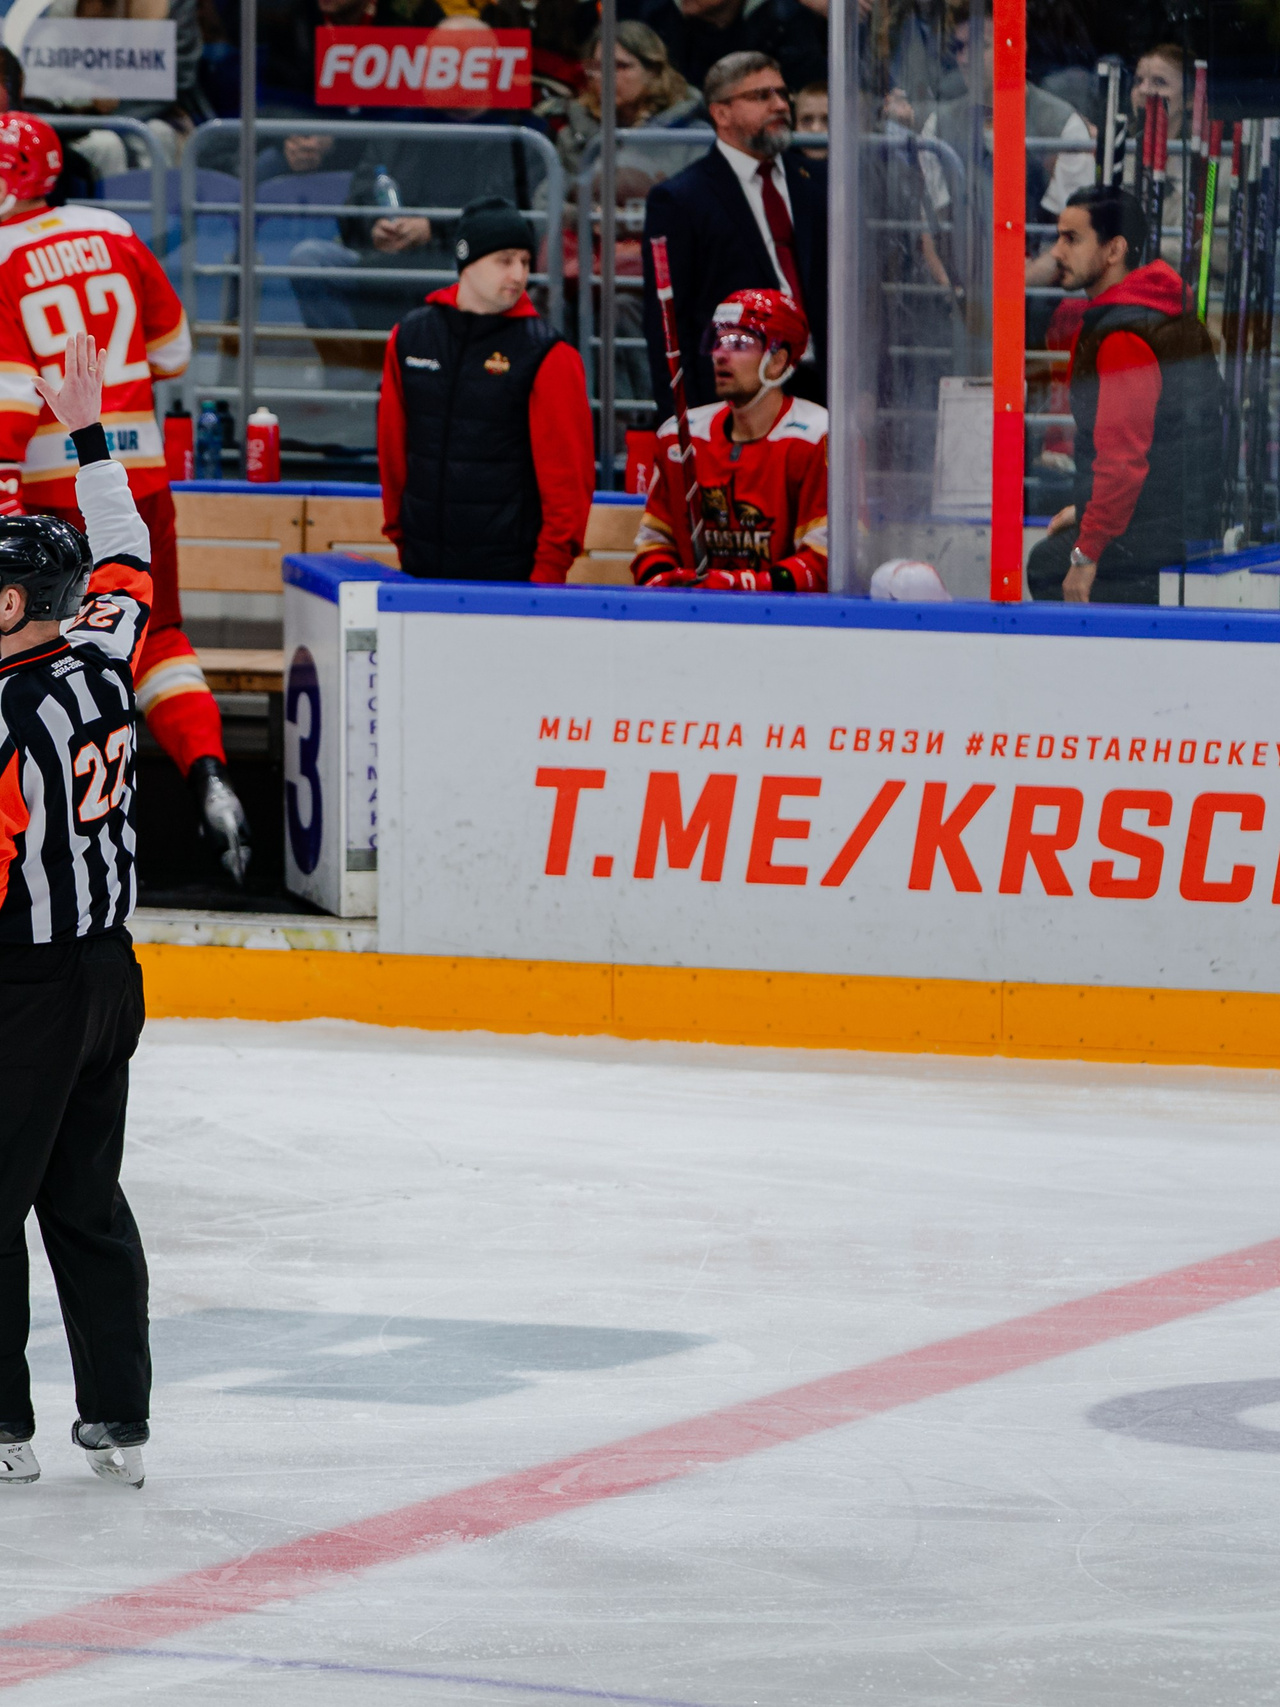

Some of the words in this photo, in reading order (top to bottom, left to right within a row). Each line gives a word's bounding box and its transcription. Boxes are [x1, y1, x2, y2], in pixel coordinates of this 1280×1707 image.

[22, 47, 166, 71] ГАЗПРОМБАНК
[320, 43, 528, 91] FONBET
[24, 235, 112, 288] JURCO
[20, 272, 151, 394] 92
[538, 716, 592, 742] МЫ
[612, 719, 743, 750] ВСЕГДА
[765, 723, 807, 750] НА
[828, 727, 945, 756] СВЯЗИ
[73, 725, 130, 823] 22
[535, 766, 1280, 905] T.ME/KRSC
